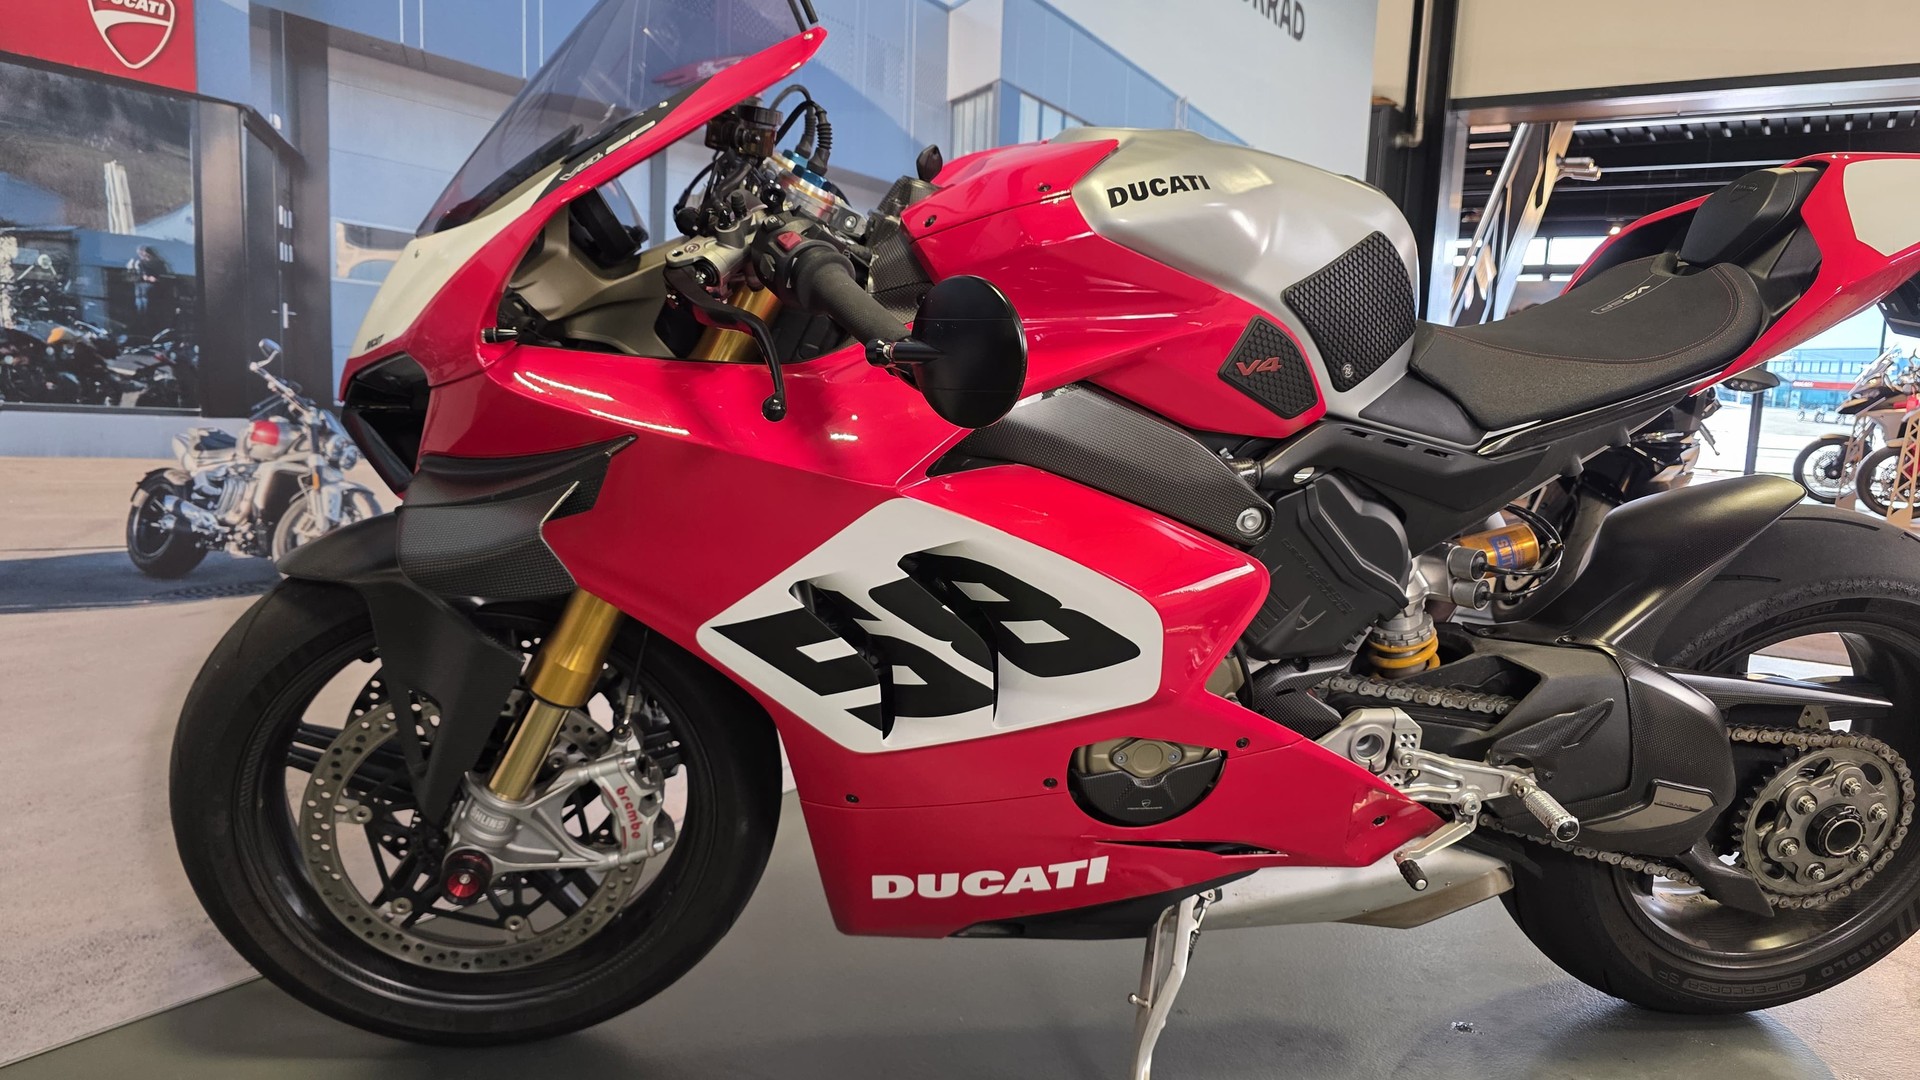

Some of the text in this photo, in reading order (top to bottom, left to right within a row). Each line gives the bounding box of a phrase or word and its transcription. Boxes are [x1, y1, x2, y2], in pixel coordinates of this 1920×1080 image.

[103, 0, 165, 16] CATI
[1106, 174, 1211, 209] DUCATI
[1236, 356, 1283, 376] V4
[616, 785, 644, 840] brembo
[871, 855, 1109, 900] DUCATI
[1820, 930, 1896, 978] DIABLO
[1687, 977, 1806, 995] SUPERCORSA
